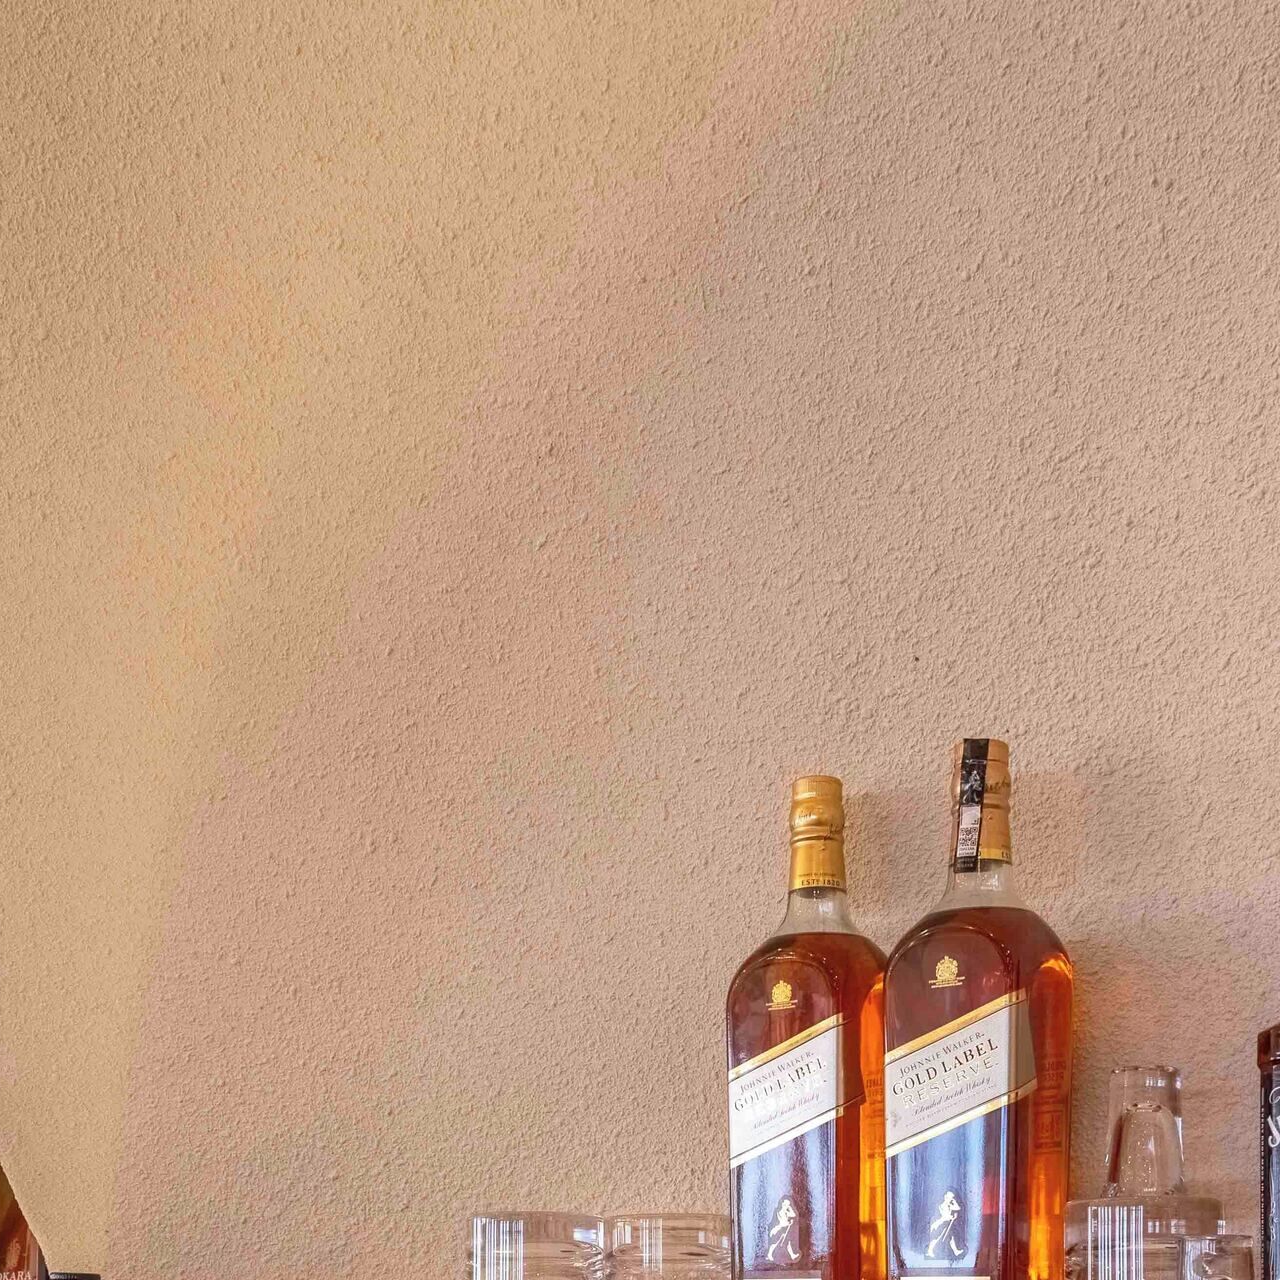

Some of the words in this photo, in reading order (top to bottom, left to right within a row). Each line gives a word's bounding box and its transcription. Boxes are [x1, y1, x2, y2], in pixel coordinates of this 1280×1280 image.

[740, 1069, 776, 1095] JOHNNIE
[777, 1051, 811, 1074] WALKER
[892, 1066, 938, 1097] GOLD
[942, 1038, 999, 1073] LABEL
[900, 1052, 941, 1079] JOHNNIE
[943, 1031, 982, 1055] WALKER
[734, 1086, 774, 1112] GOLD
[902, 1056, 993, 1109] RESERVE
